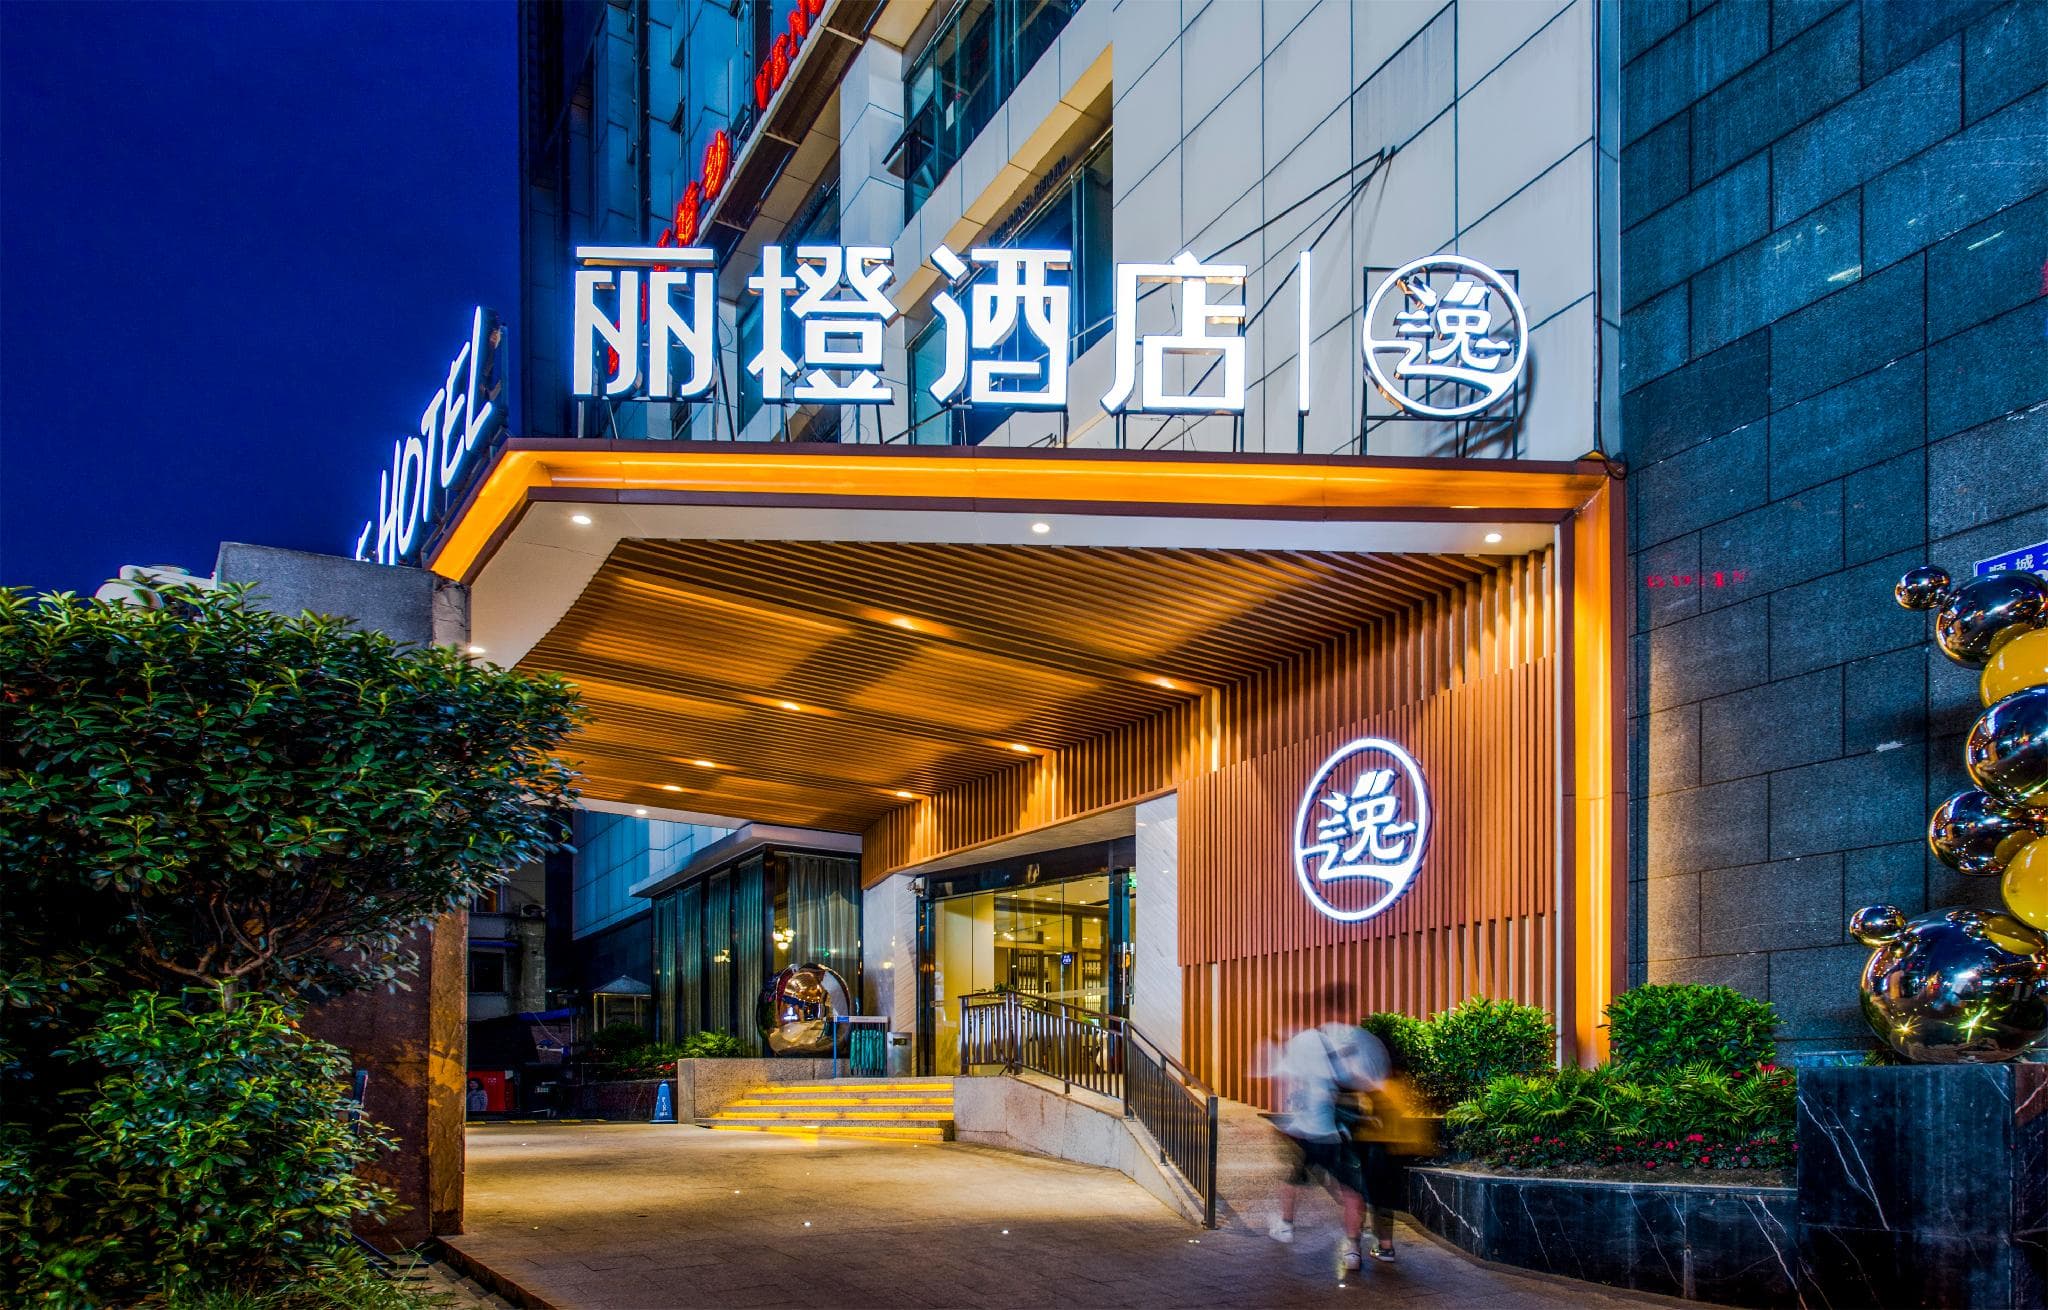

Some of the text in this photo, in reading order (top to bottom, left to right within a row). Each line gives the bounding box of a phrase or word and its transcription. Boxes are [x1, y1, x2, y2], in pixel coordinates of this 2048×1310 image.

[573, 244, 1247, 412] 丽橙酒店
[1368, 277, 1524, 399] 逸
[378, 305, 492, 566] HOTEL
[1297, 766, 1422, 892] 逸
